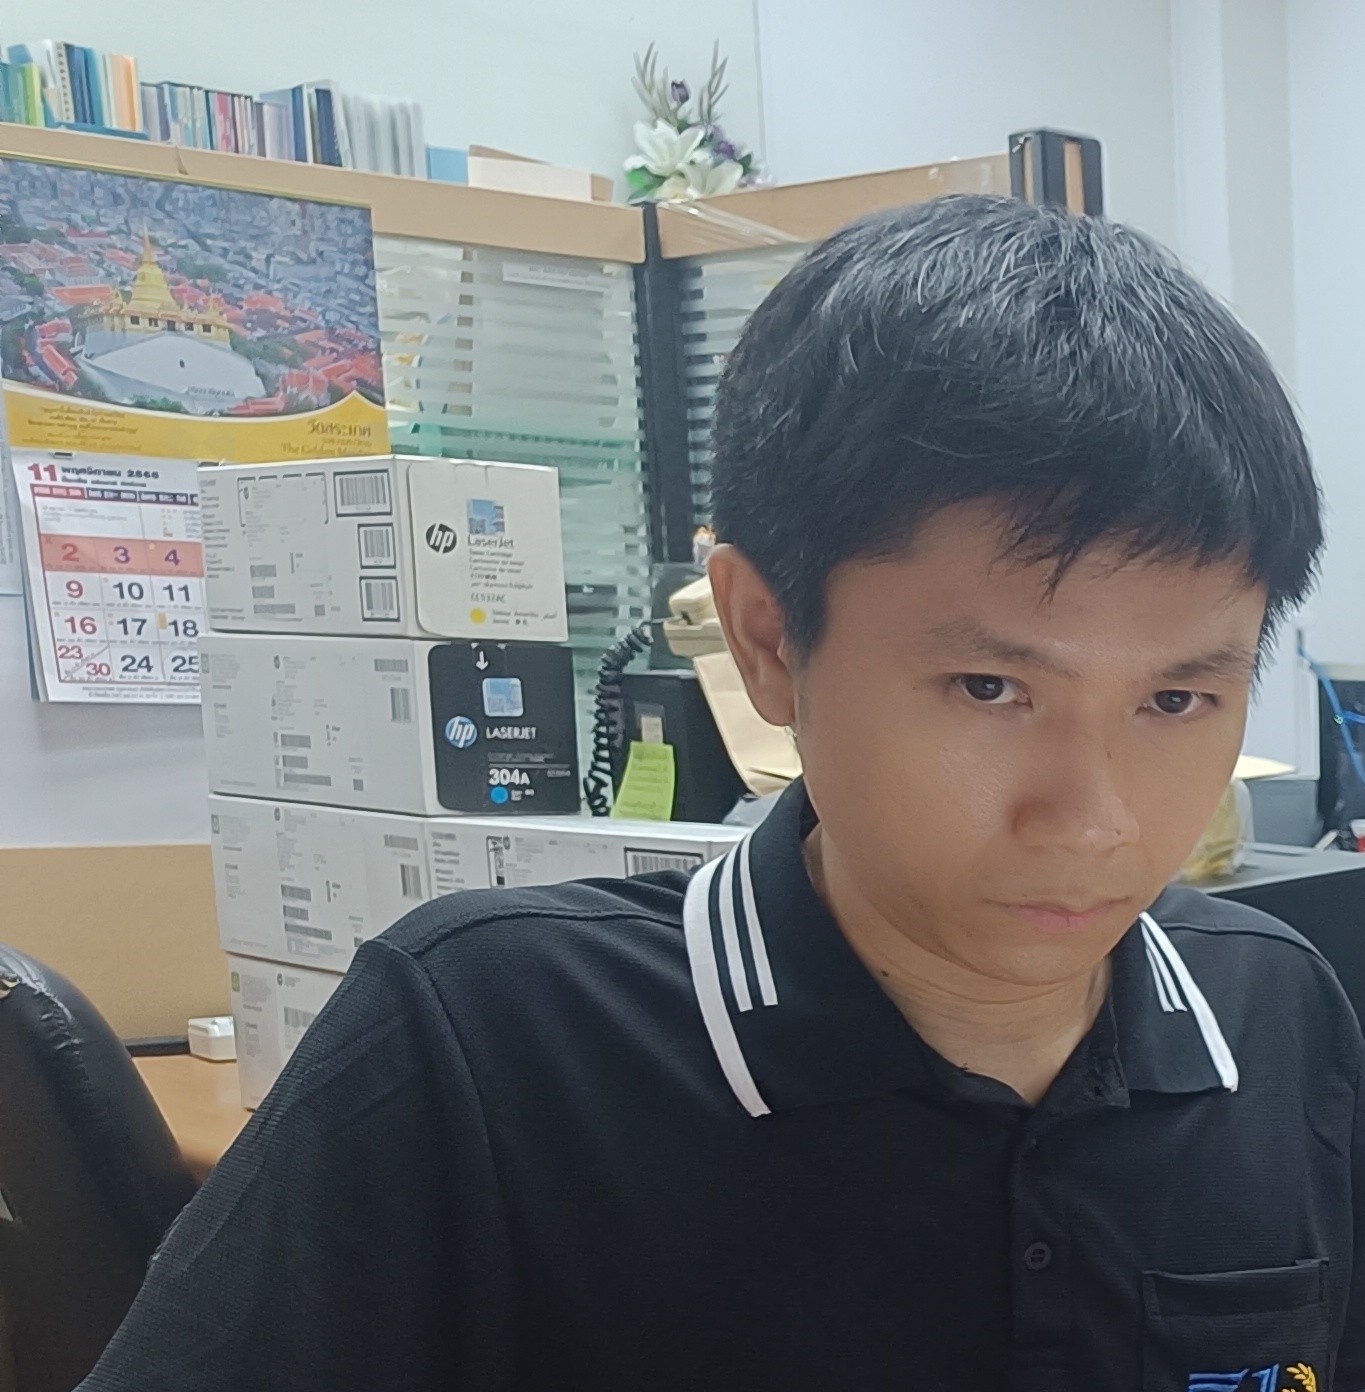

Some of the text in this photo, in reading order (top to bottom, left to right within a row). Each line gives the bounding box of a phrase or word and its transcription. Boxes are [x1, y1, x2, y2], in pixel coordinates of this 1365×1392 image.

[28, 463, 58, 482] 11
[426, 523, 457, 554] hp
[467, 535, 514, 548] LaserJet
[61, 543, 181, 566] 2 3 4
[65, 580, 191, 602] 9 10 11
[64, 616, 200, 638] 16 17 18
[58, 645, 84, 660] 23
[85, 663, 111, 677] 30
[120, 655, 154, 673] 24
[445, 716, 478, 748] hp
[486, 726, 537, 739] LASERJET
[488, 768, 531, 785] 304A
